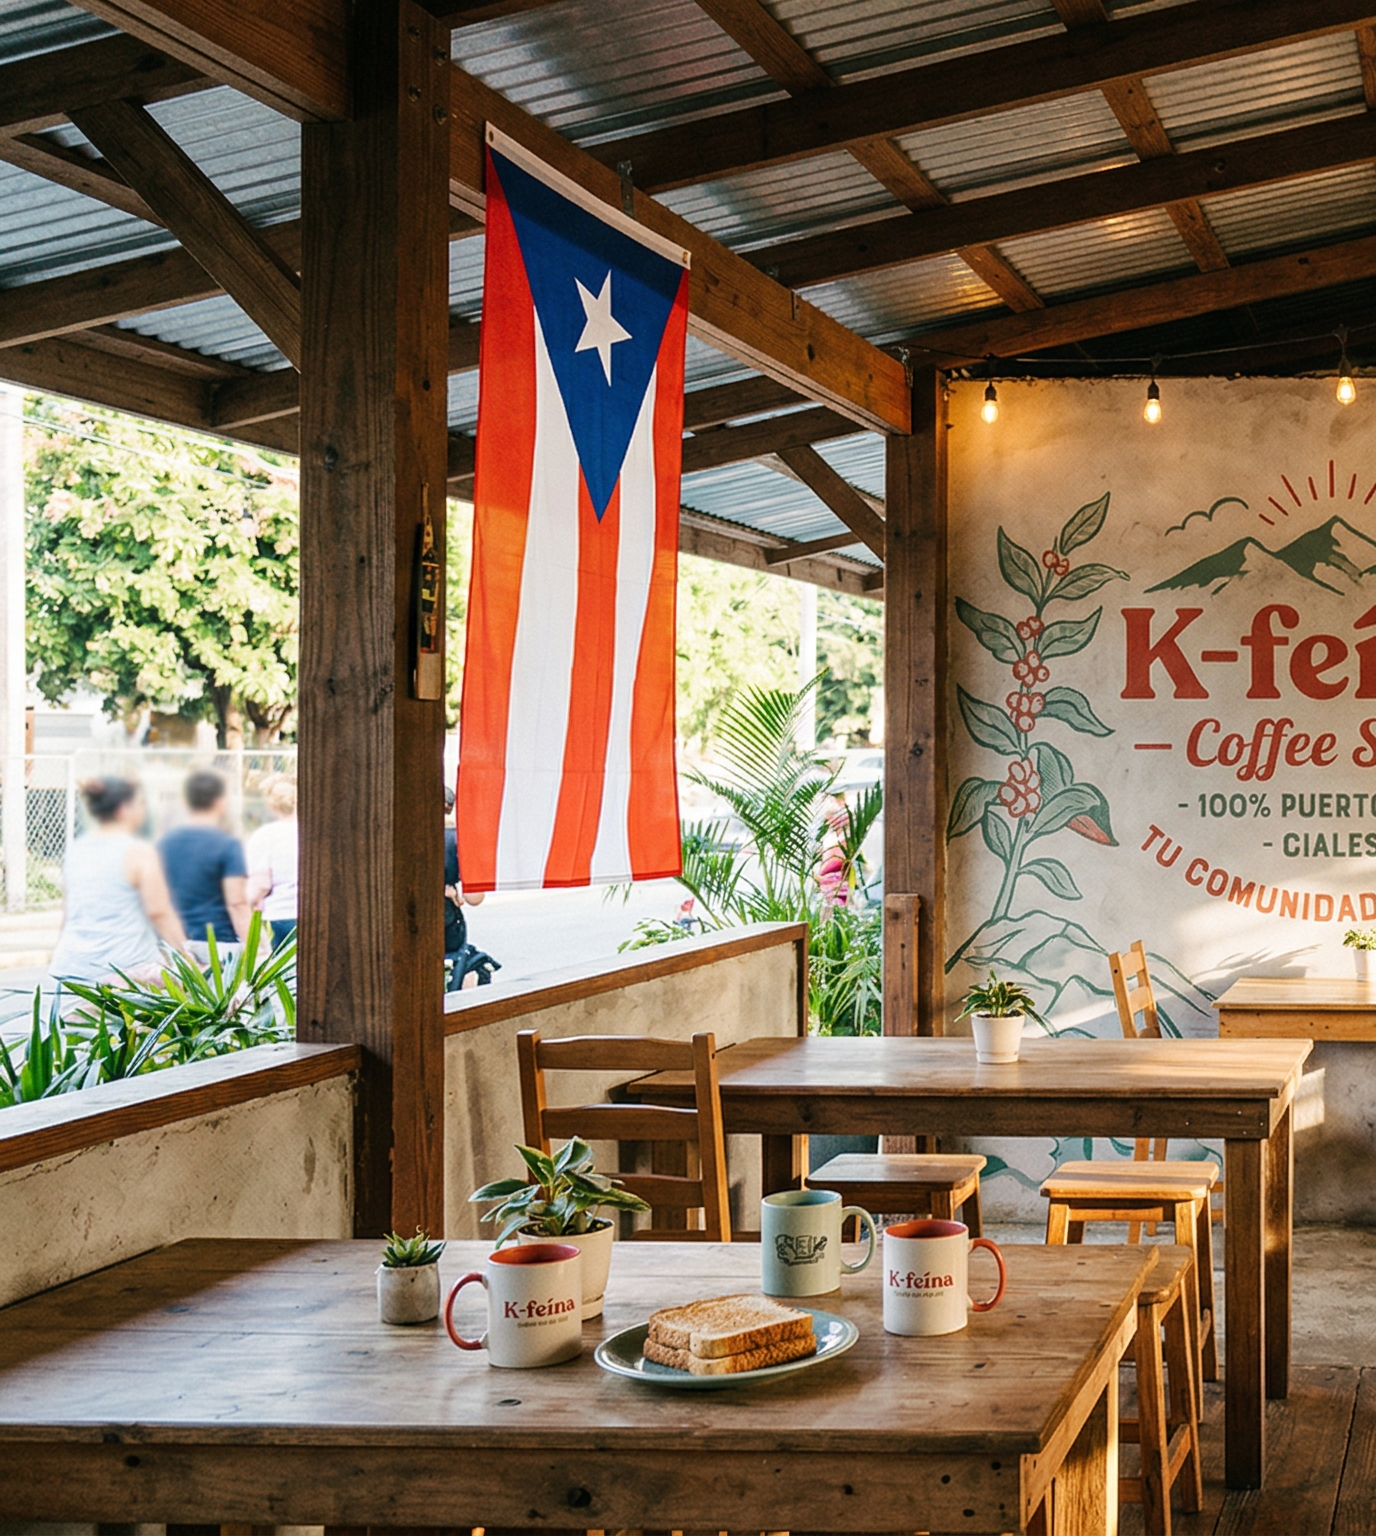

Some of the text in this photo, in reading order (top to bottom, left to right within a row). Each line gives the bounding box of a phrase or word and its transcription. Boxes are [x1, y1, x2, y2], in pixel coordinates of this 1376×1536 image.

[1186, 717, 1338, 782] Coffee
[1198, 793, 1272, 819] 100%
[1141, 824, 1184, 868] TU
[888, 1269, 955, 1290] K-feína
[503, 1297, 576, 1319] K-feína
